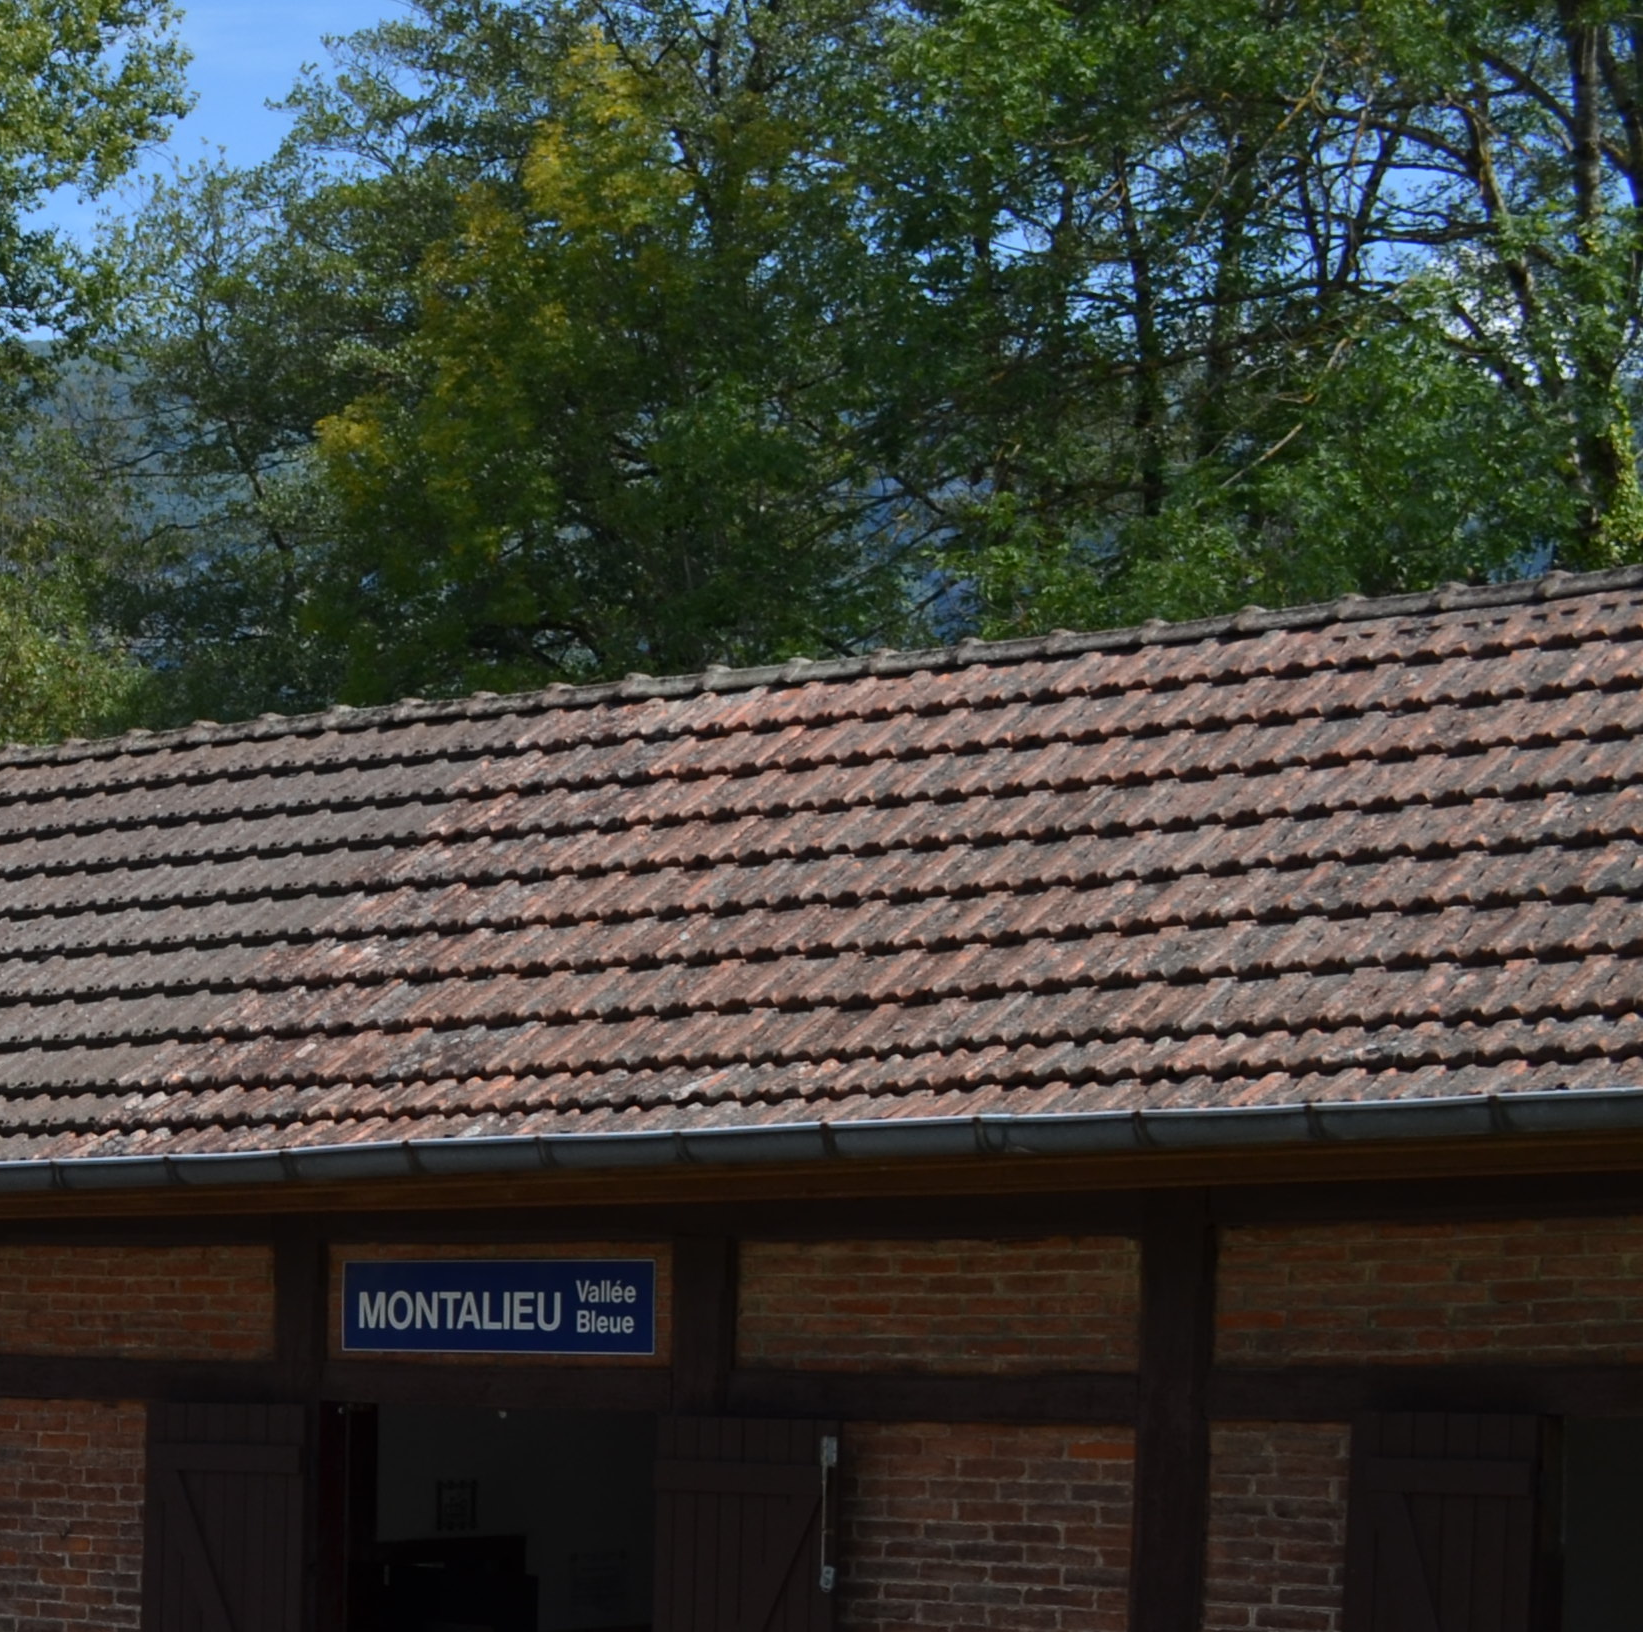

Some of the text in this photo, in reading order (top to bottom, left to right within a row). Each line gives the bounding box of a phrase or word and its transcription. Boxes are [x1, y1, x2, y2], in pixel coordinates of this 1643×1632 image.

[576, 1279, 636, 1303] Vallée
[358, 1290, 562, 1331] MONTALIEU
[576, 1309, 635, 1334] Bleue
